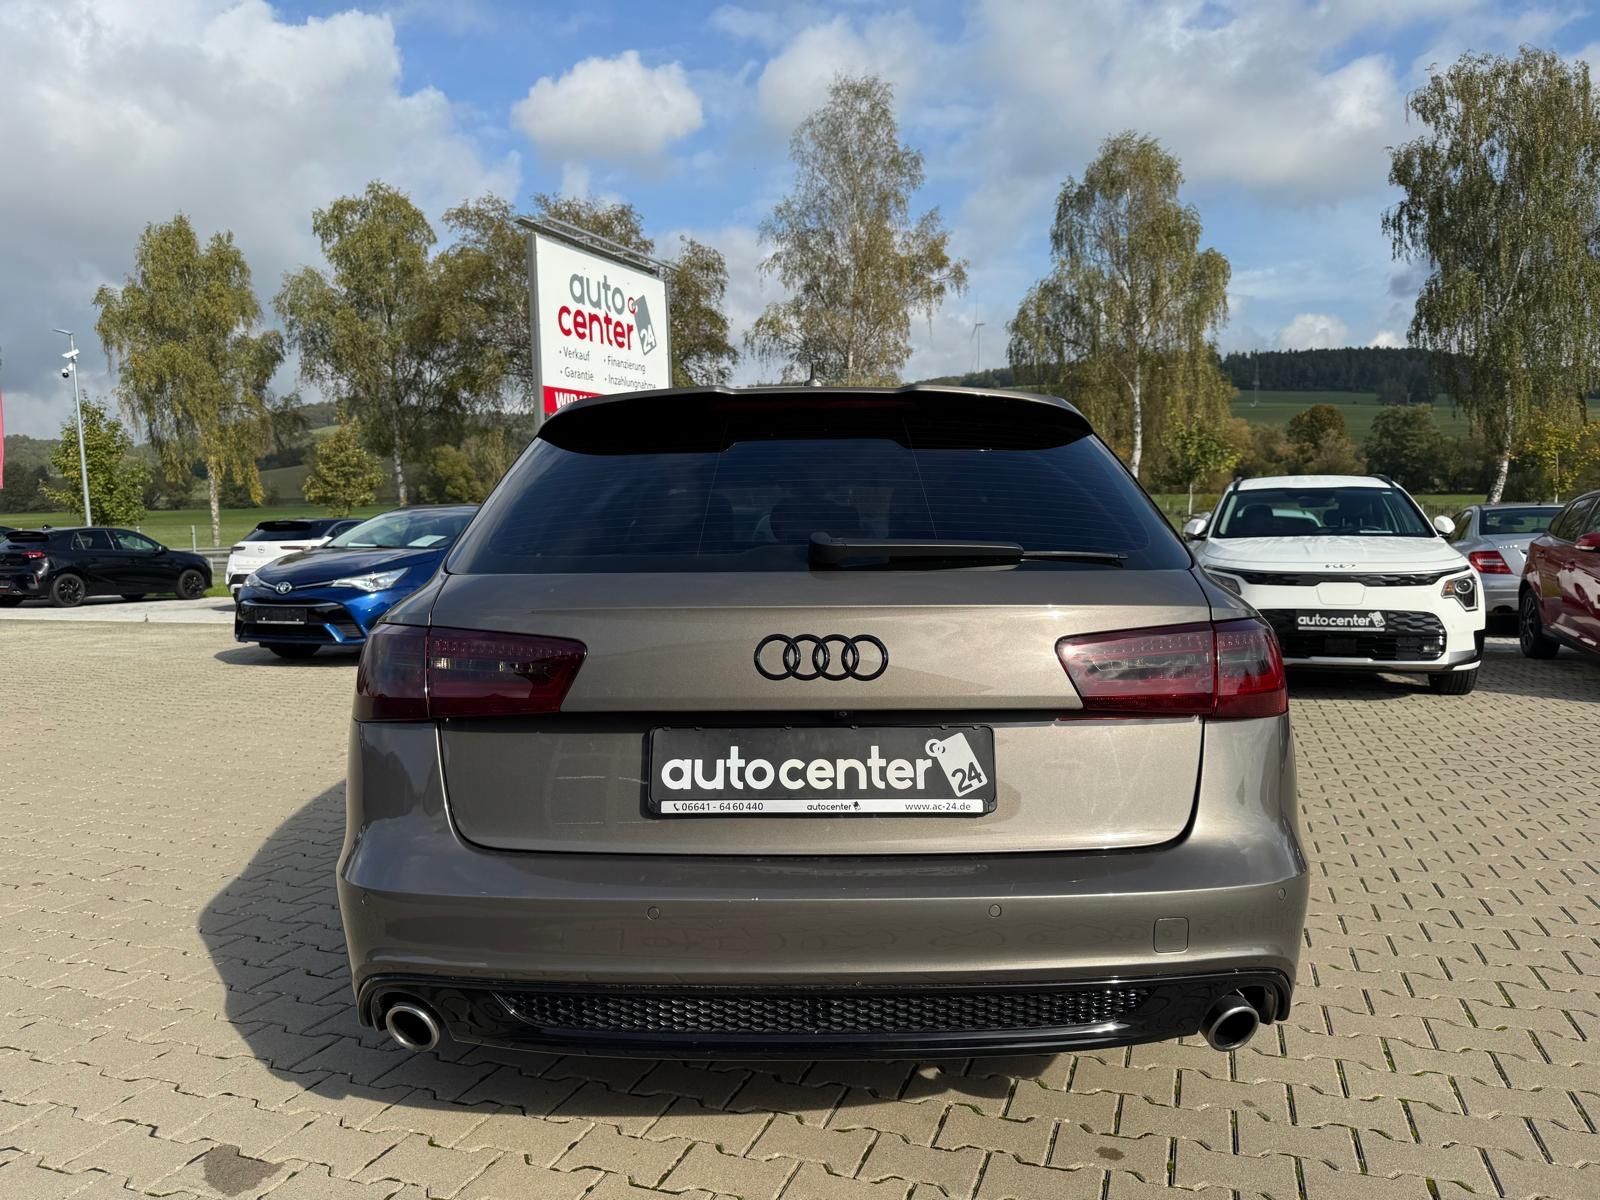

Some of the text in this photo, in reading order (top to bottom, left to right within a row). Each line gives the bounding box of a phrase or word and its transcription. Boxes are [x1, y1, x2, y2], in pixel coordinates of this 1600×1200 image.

[569, 273, 625, 315] auto
[558, 305, 634, 350] center
[640, 324, 655, 352] 24
[563, 346, 591, 361] Verkauf
[607, 355, 646, 375] Finanzierung
[564, 366, 595, 382] Garantie
[1297, 613, 1371, 626] autocenter
[661, 745, 983, 793] autocenter 24
[681, 802, 710, 811] 06641
[806, 802, 852, 811] autocenter
[904, 802, 971, 811] www.ac-24.de
